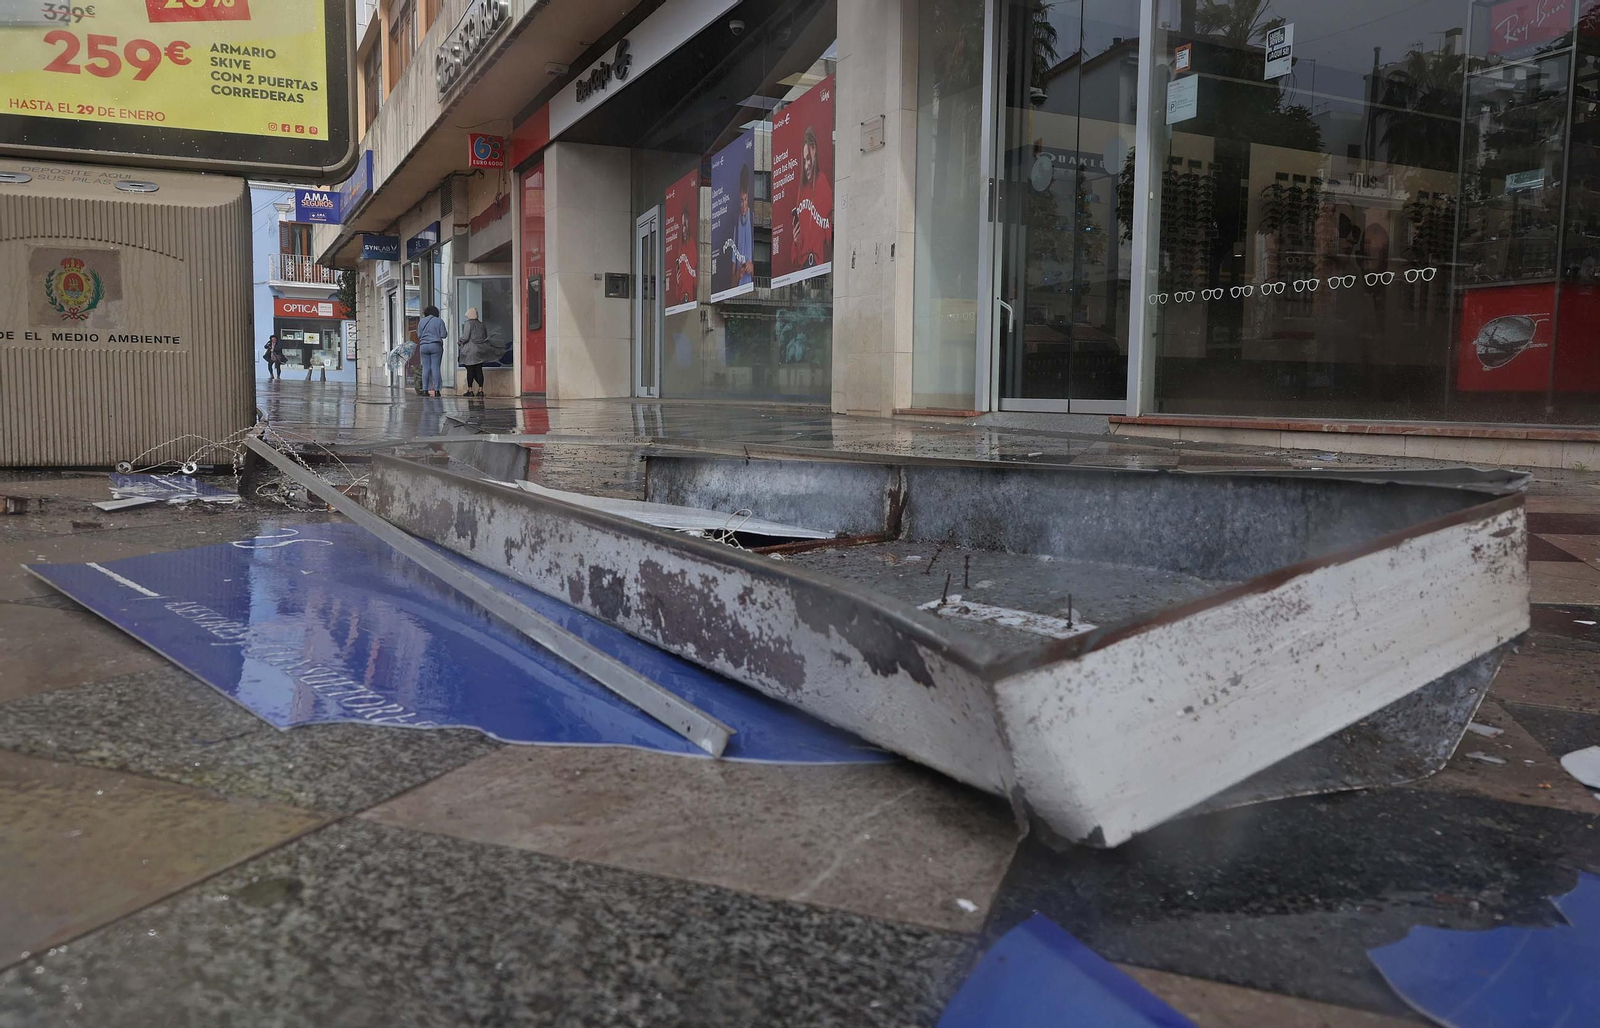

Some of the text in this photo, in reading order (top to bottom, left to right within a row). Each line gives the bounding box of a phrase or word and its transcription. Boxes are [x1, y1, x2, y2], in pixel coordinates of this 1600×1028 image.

[43, 2, 96, 24] 329€
[42, 29, 193, 82] 259€
[210, 42, 277, 59] ARMARIO
[210, 56, 252, 71] SKIVE
[210, 70, 319, 92] CON 2 PUERTAS
[210, 84, 305, 104] CORREDERAS
[9, 98, 166, 122] HASTA EL 29 DE ENERO
[21, 166, 132, 180] DEPOSITE AQUI
[37, 174, 112, 186] SUS PILAS
[301, 199, 334, 208] SEGUROS
[304, 192, 331, 202] A.M.A.
[364, 244, 391, 252] SYNLAB
[283, 303, 318, 314] OPTICA
[0, 331, 181, 345] DE EL MEDIO AMBIENTE
